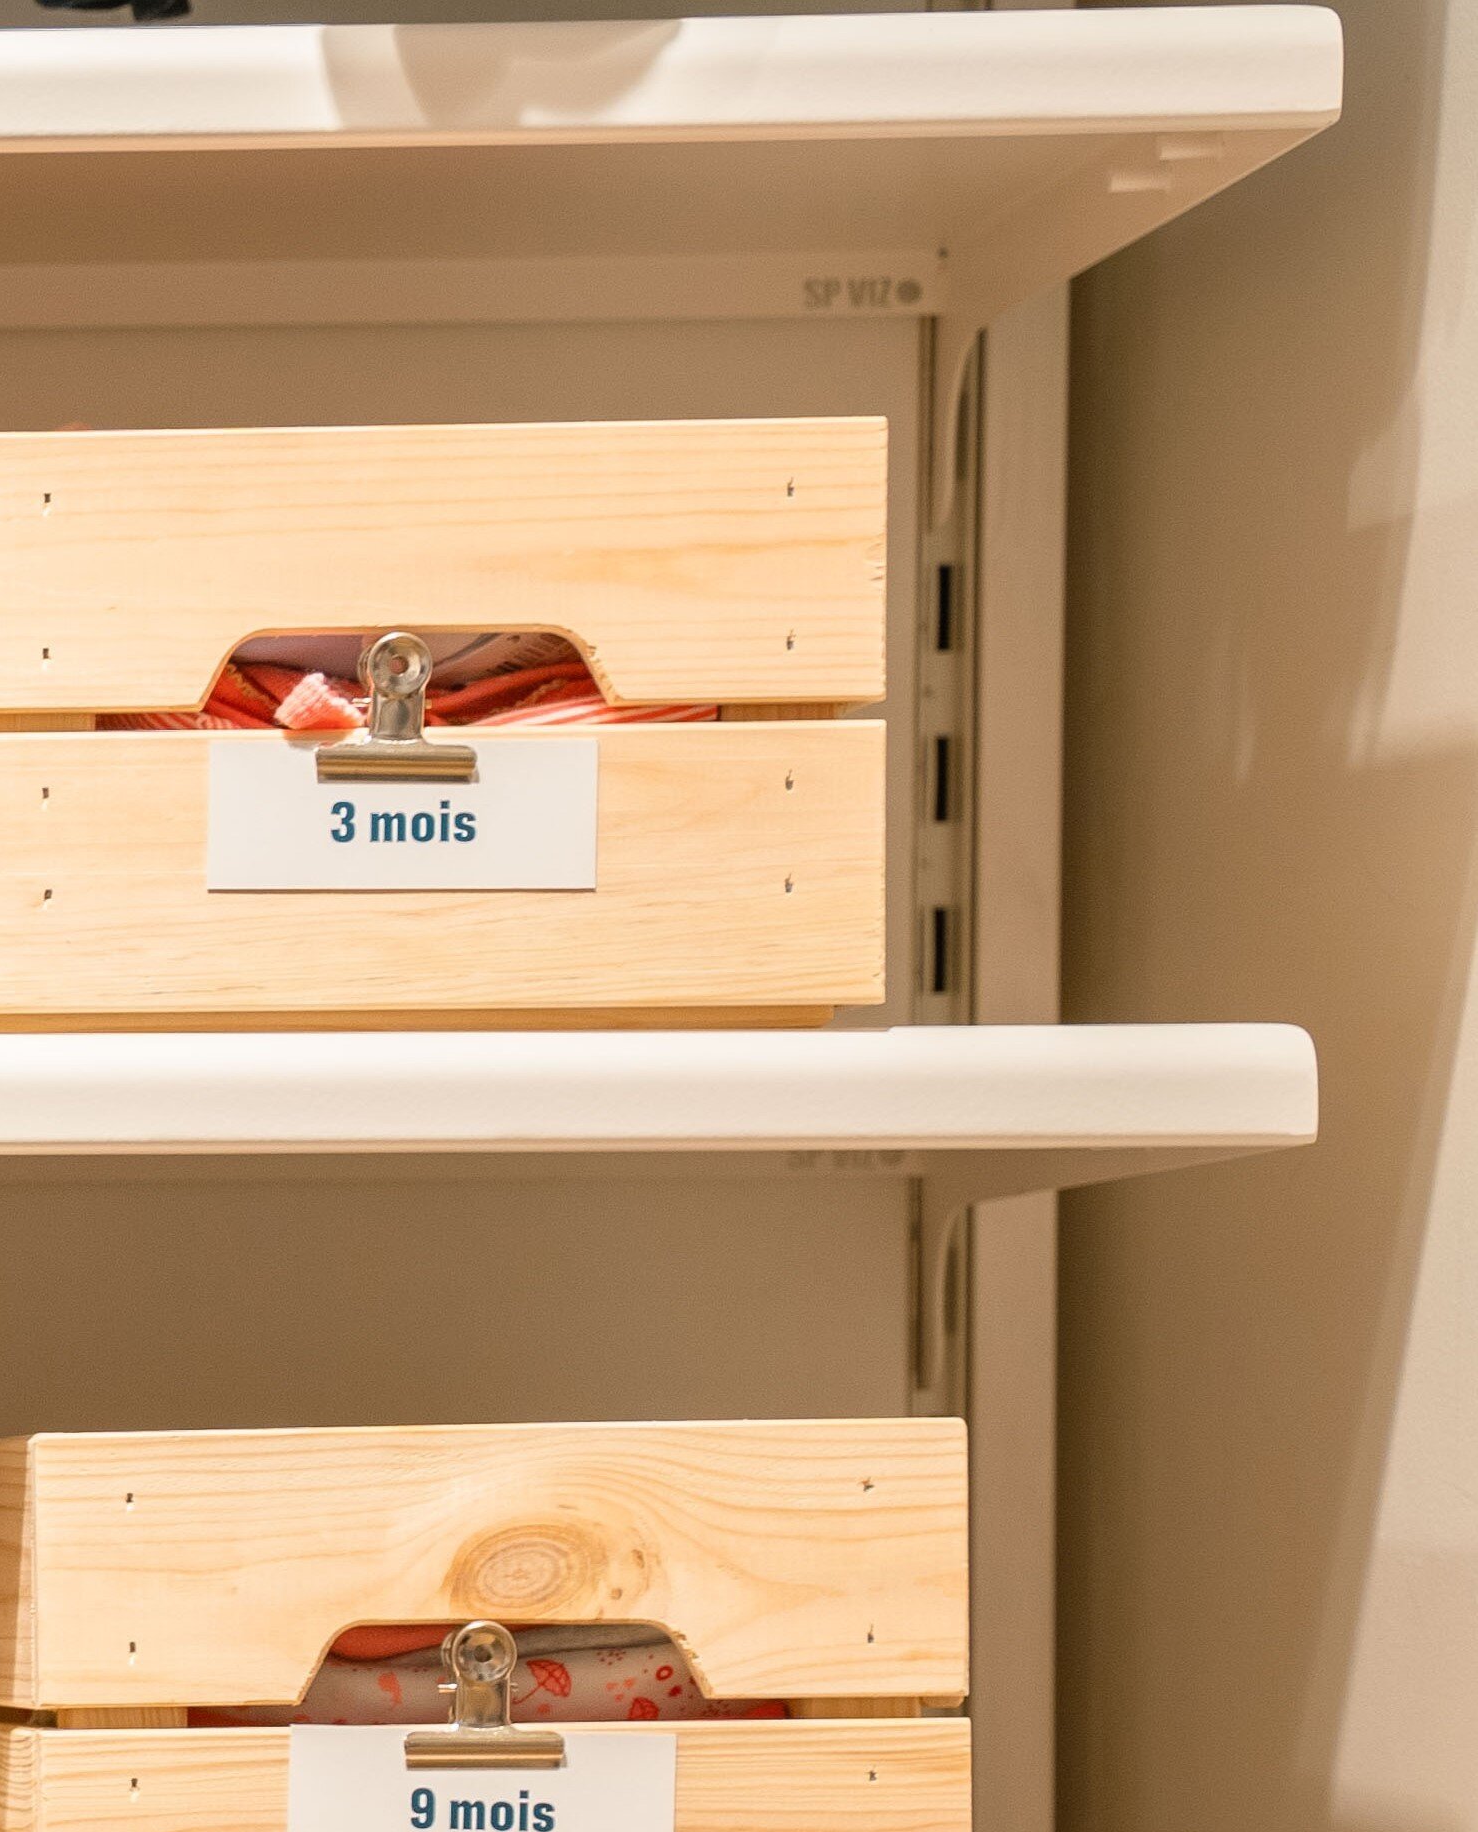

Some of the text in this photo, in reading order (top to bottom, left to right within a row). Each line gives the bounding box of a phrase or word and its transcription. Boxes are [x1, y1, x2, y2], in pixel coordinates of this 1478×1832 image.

[330, 800, 477, 844] 3 mois
[410, 1787, 555, 1832] 9 mois
